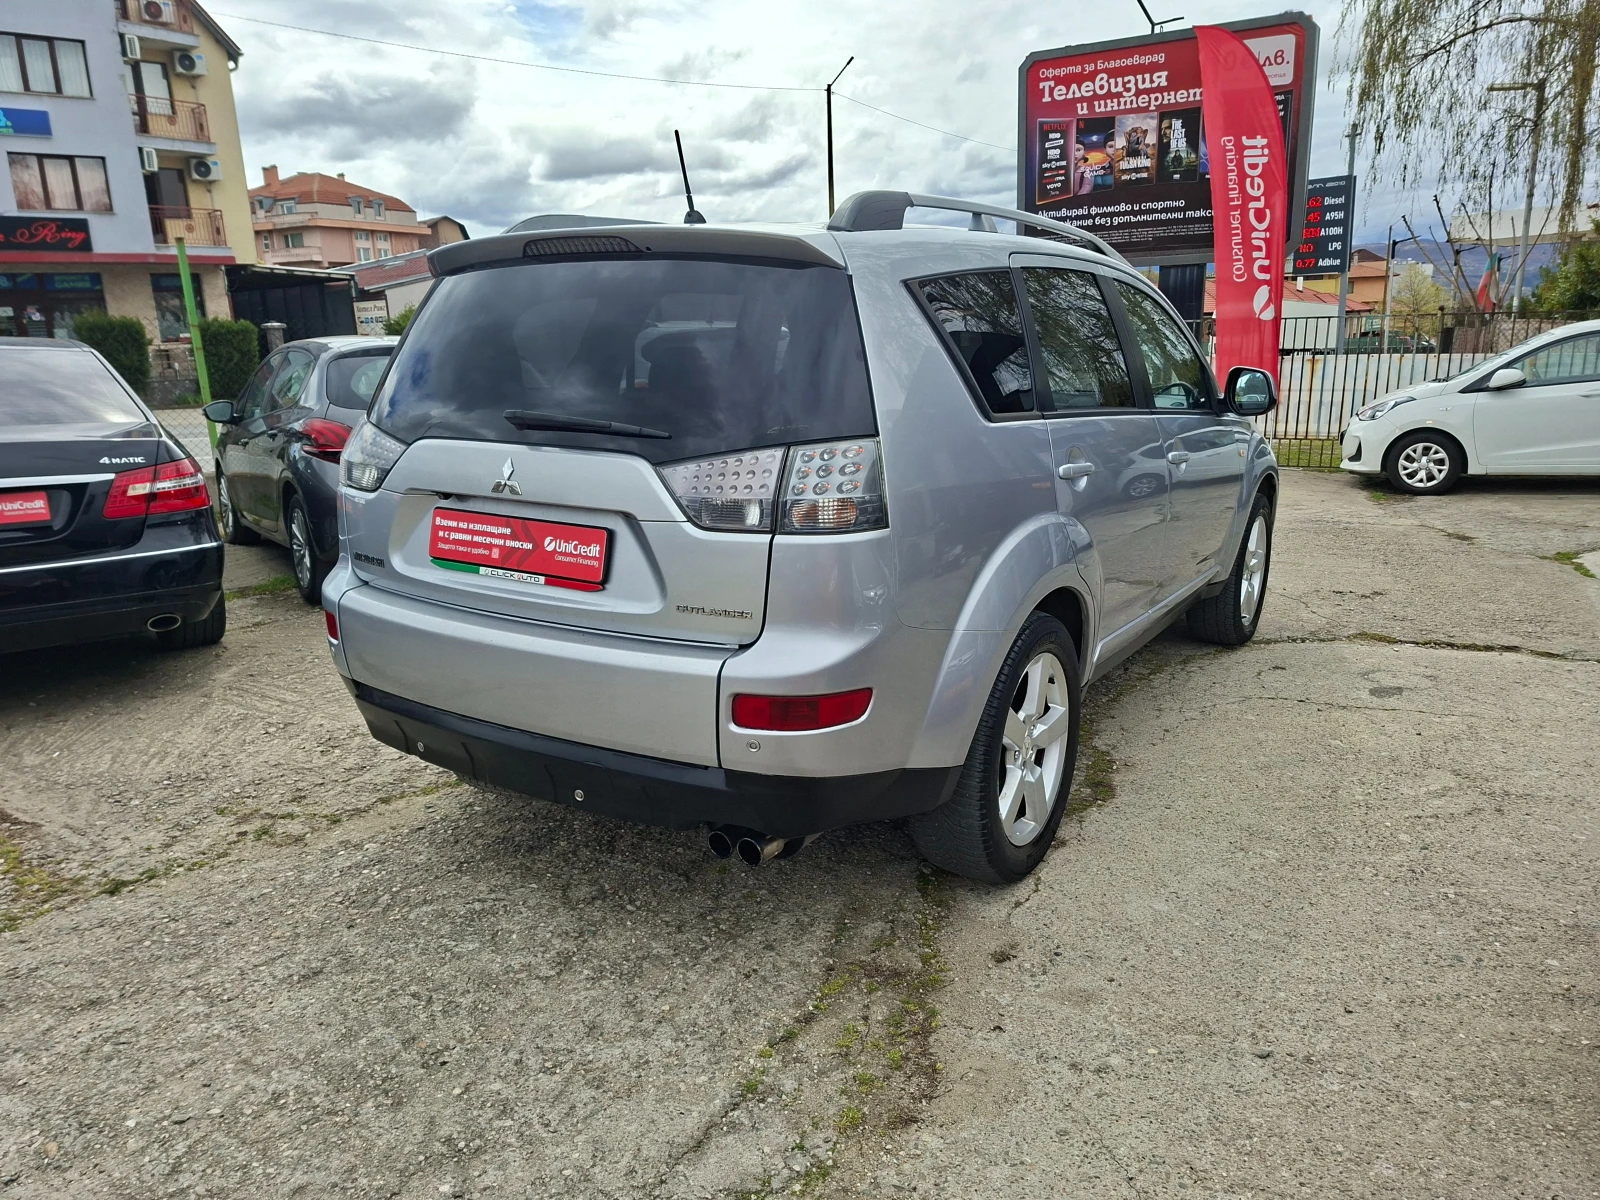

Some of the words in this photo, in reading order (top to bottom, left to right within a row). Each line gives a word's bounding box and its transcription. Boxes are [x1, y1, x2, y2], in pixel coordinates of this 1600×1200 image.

[1039, 65, 1081, 79] Оферта
[1083, 63, 1095, 74] за
[1097, 52, 1165, 70] Благоевград
[1039, 71, 1168, 103] Телевизия
[1076, 102, 1088, 115] и
[1043, 123, 1067, 131] NETFLIX
[1171, 118, 1183, 129] THE
[1170, 128, 1186, 139] LAST
[1170, 138, 1178, 149] OF
[1178, 137, 1187, 148] US
[1324, 195, 1345, 205] Diesel
[1037, 205, 1088, 218] Активирай
[1089, 202, 1131, 216] филмово
[1141, 199, 1185, 211] спортно
[1095, 216, 1111, 226] без
[1113, 211, 1184, 226] допълнителни
[1325, 211, 1344, 221] A95H
[10, 220, 88, 248] Ring
[1320, 226, 1343, 237] A100H
[1328, 242, 1342, 251] LPG
[1296, 258, 1316, 268] 0.77
[1318, 257, 1340, 267] Adblue
[2, 499, 45, 511] UniCredit
[435, 516, 457, 528] Вземи
[458, 521, 467, 529] на
[469, 522, 511, 535] изплащане
[437, 541, 455, 550] Защото
[450, 531, 471, 541] равни
[473, 535, 504, 546] месечни
[505, 540, 533, 550] вноски
[556, 538, 600, 558] UniCredit
[555, 553, 577, 563] Consumer
[577, 557, 599, 568] Financing
[490, 569, 516, 579] CLICK
[675, 604, 753, 620] OUTLANDER
